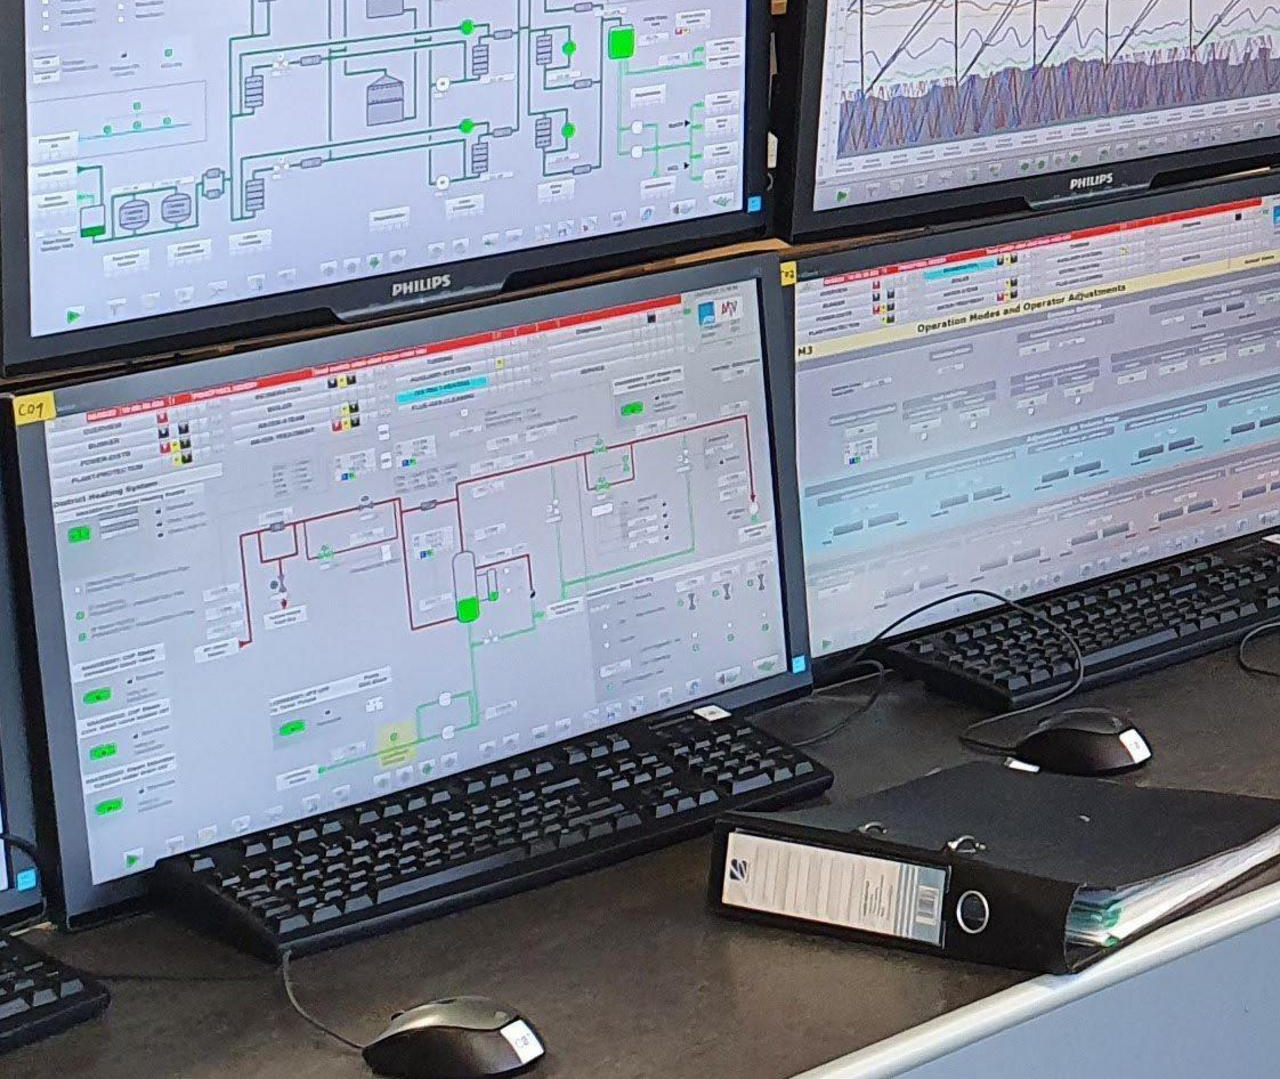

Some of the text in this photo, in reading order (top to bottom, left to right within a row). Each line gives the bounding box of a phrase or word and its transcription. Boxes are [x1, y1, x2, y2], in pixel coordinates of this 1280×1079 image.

[1070, 173, 1113, 190] PHILIPS
[392, 275, 451, 297] PHILIPS
[917, 283, 1126, 333] Operation Modes and Operator Adjustments
